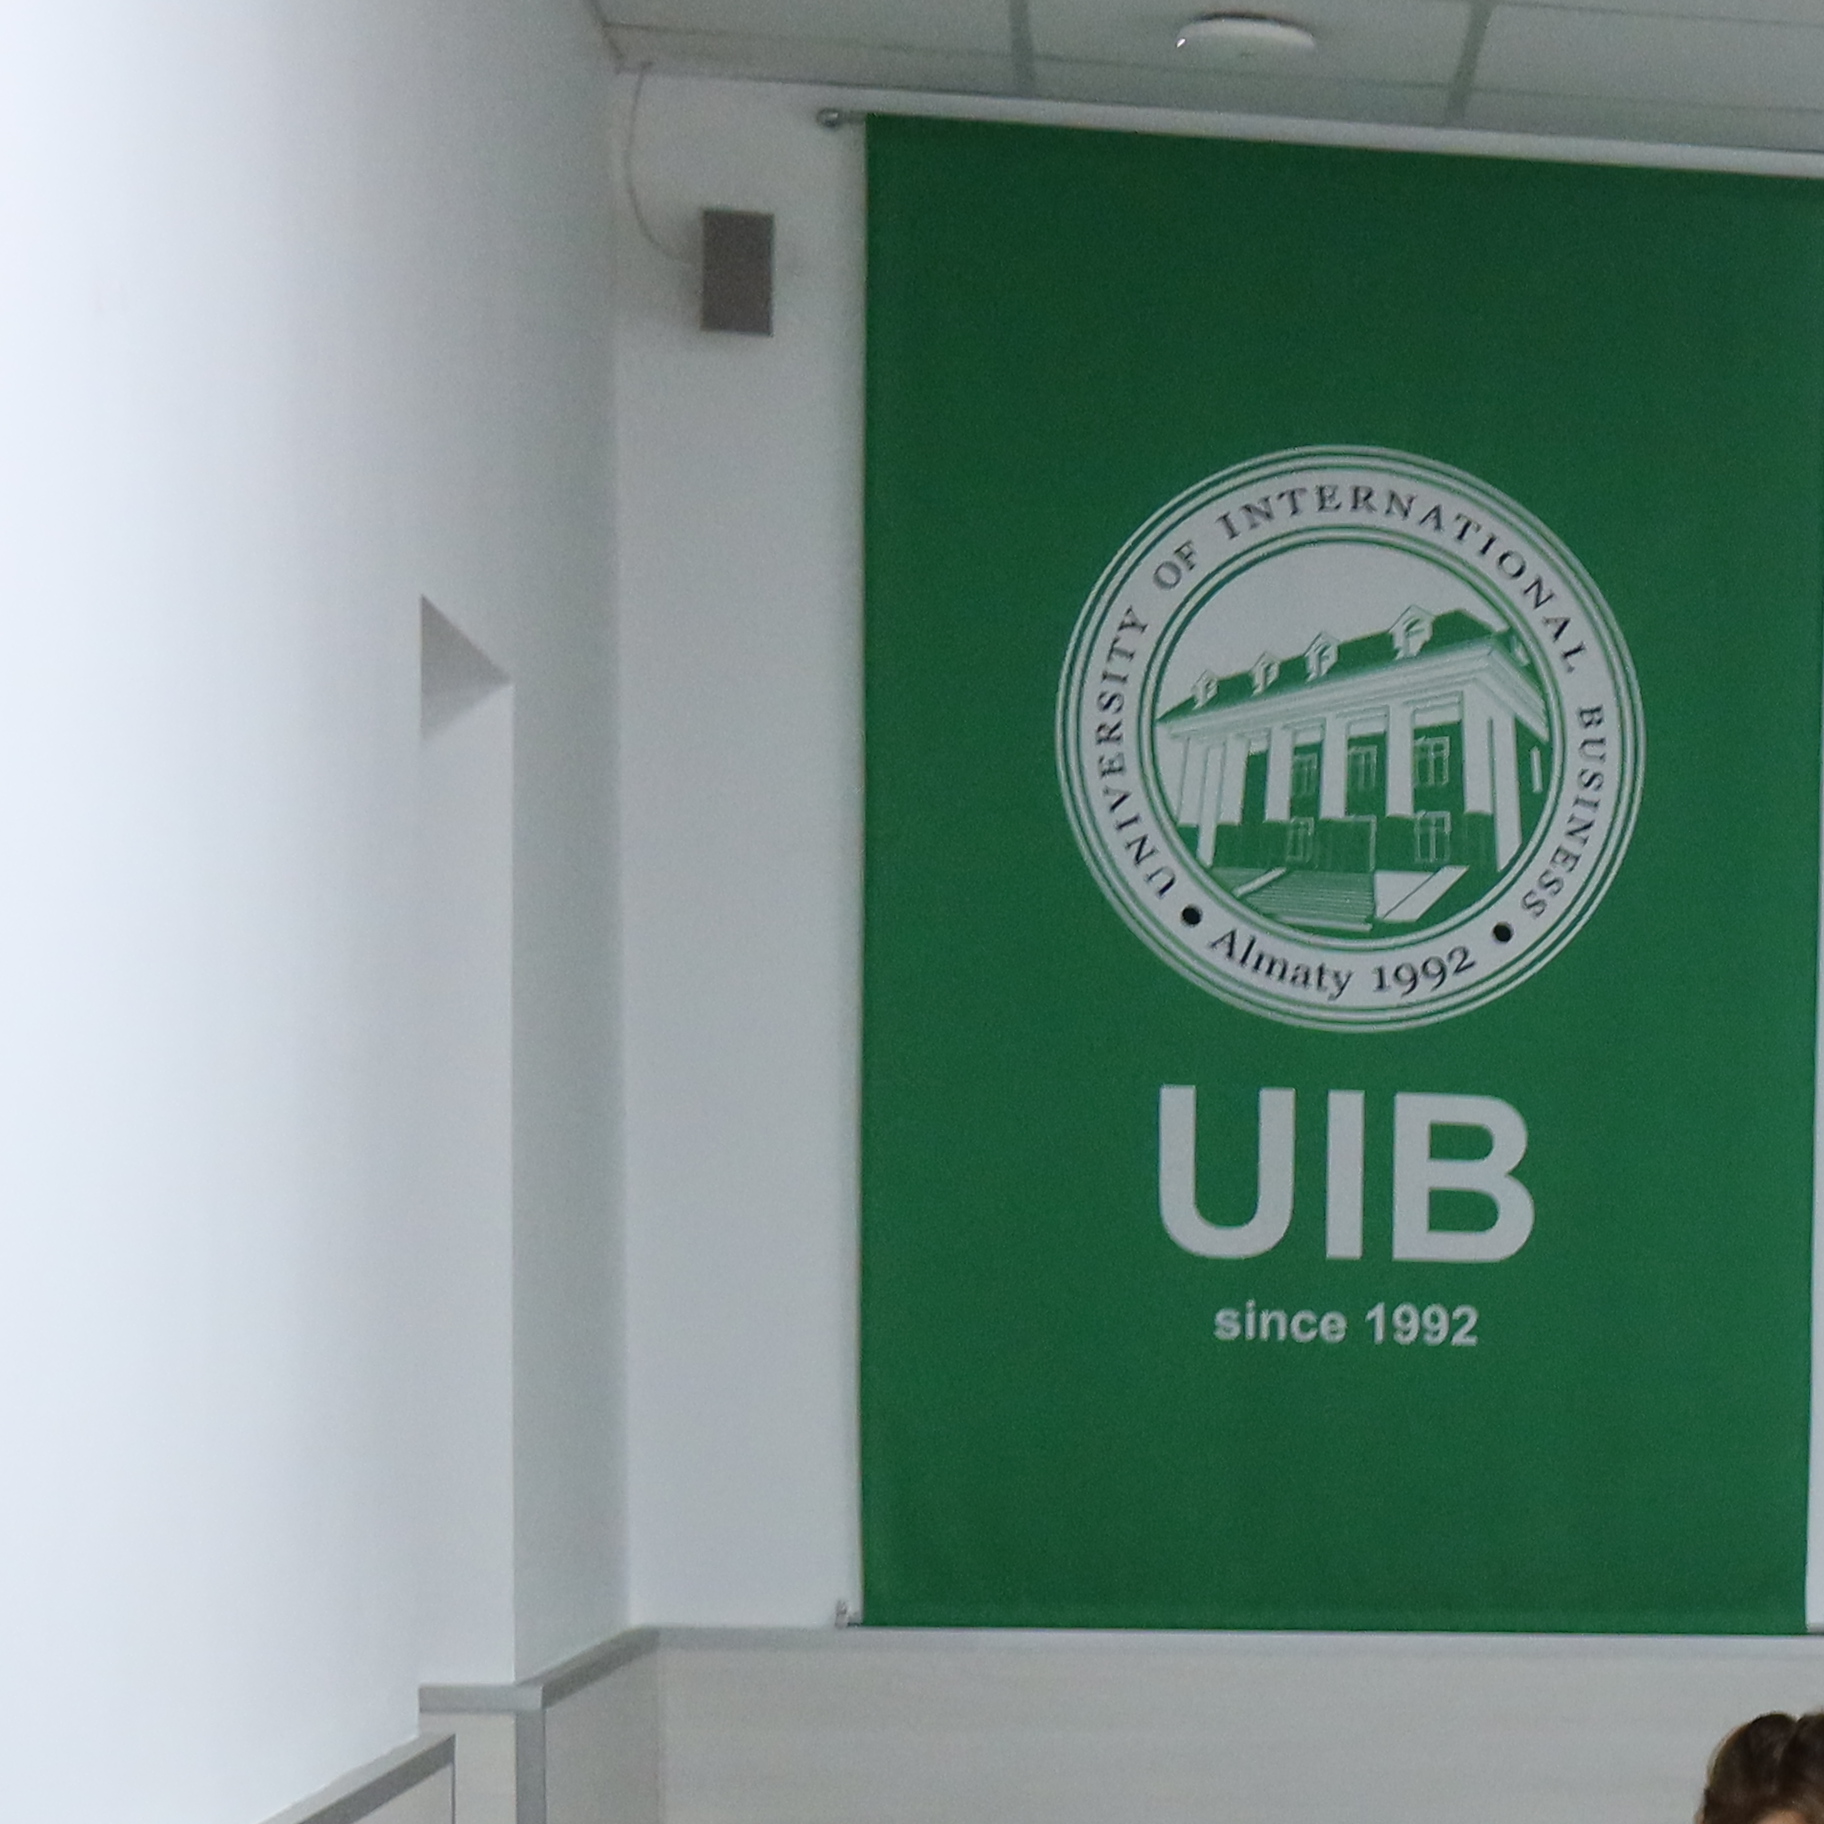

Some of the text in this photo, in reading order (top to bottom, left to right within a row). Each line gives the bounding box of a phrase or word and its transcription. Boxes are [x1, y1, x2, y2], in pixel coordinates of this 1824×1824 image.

[1095, 483, 1606, 922] UNIVERSITY OF INTERNATIONAL BUSINESS
[1209, 925, 1477, 1001] Almaty 1992
[1159, 1085, 1535, 1263] UIB
[1214, 1299, 1479, 1347] since 1992
